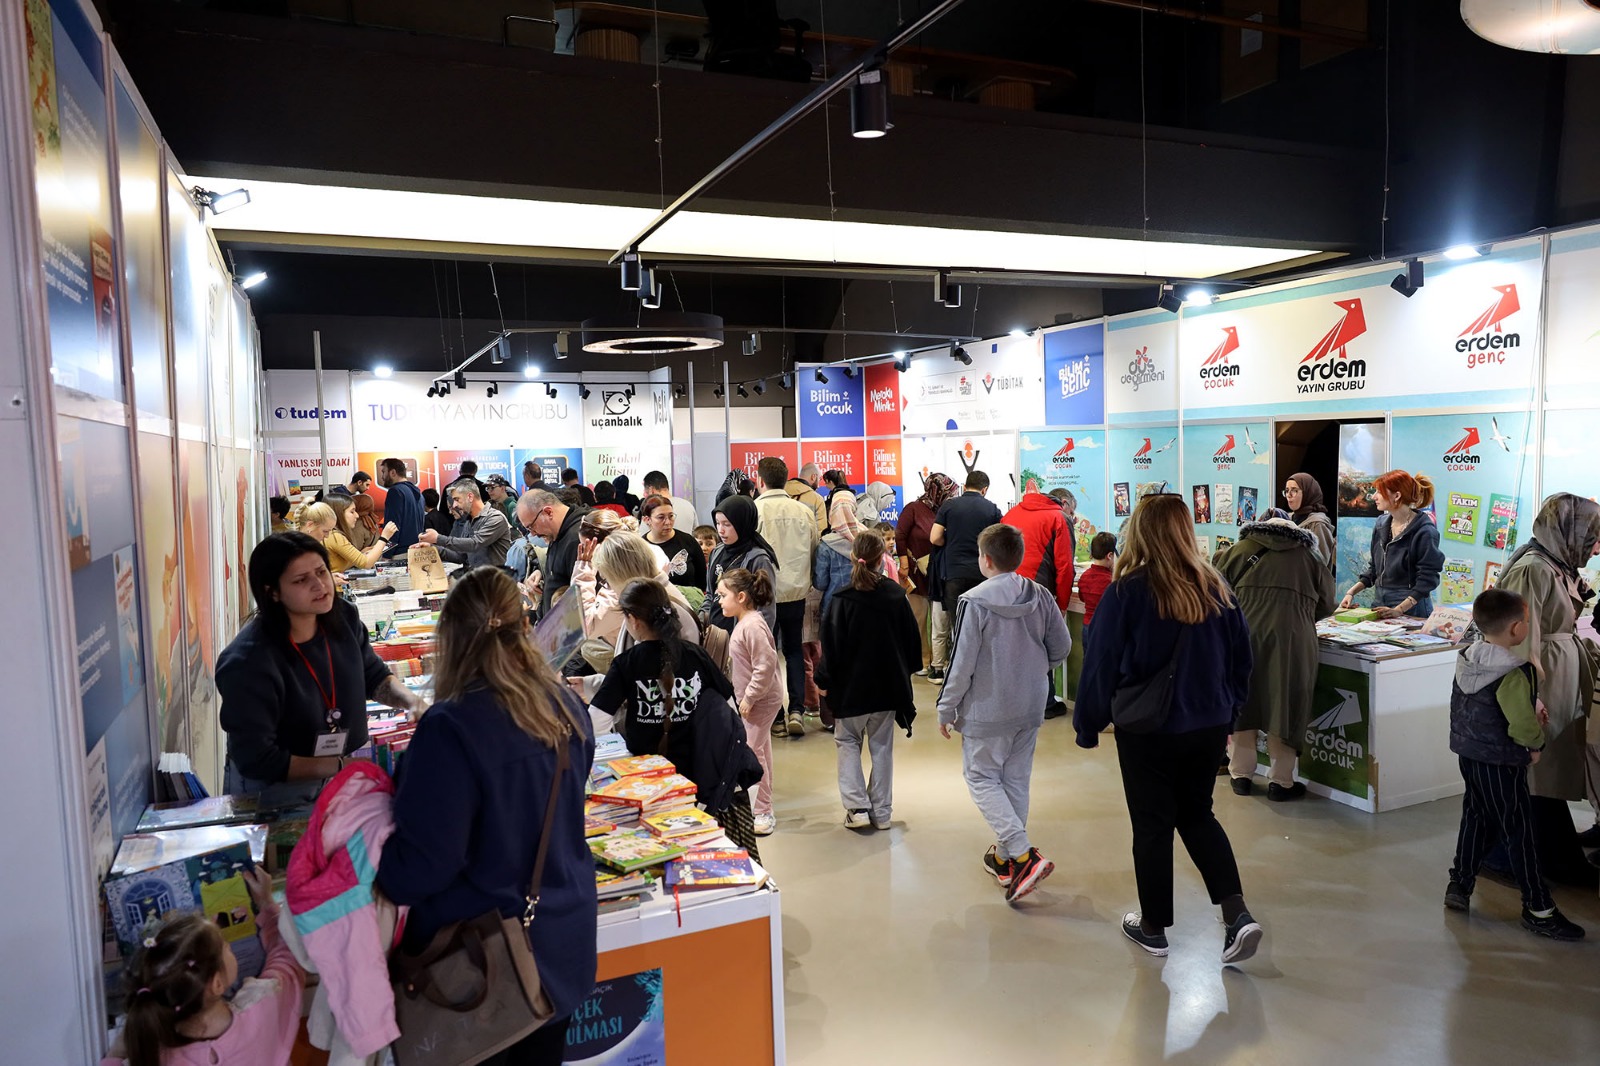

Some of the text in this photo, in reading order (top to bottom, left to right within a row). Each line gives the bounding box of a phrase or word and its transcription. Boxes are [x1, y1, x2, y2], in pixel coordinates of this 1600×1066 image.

[1455, 333, 1520, 352] erdem
[1467, 351, 1506, 369] genç
[1200, 364, 1240, 379] erdem
[1297, 358, 1366, 382] erdem
[997, 375, 1024, 390] TÜBİTAK
[1204, 379, 1234, 391] çocuk
[1296, 380, 1365, 394] YAYIN GRUBU
[810, 389, 841, 402] Bilim
[816, 402, 853, 416] Çocuk
[591, 416, 643, 430] uçanbalık
[598, 453, 615, 464] Bir
[813, 450, 844, 463] Bilim
[873, 449, 892, 462] Bilim
[1133, 456, 1152, 464] erdem
[1443, 454, 1480, 463] erdem
[278, 459, 309, 469] YANLIŞ
[873, 462, 897, 476] Teknik
[1447, 464, 1475, 472] çocuk
[301, 469, 323, 478] ÇOCU
[1452, 498, 1478, 508] TAKIM
[1304, 729, 1363, 759] erdem
[1310, 748, 1355, 771] çocuk
[570, 996, 603, 1025] ÇEK
